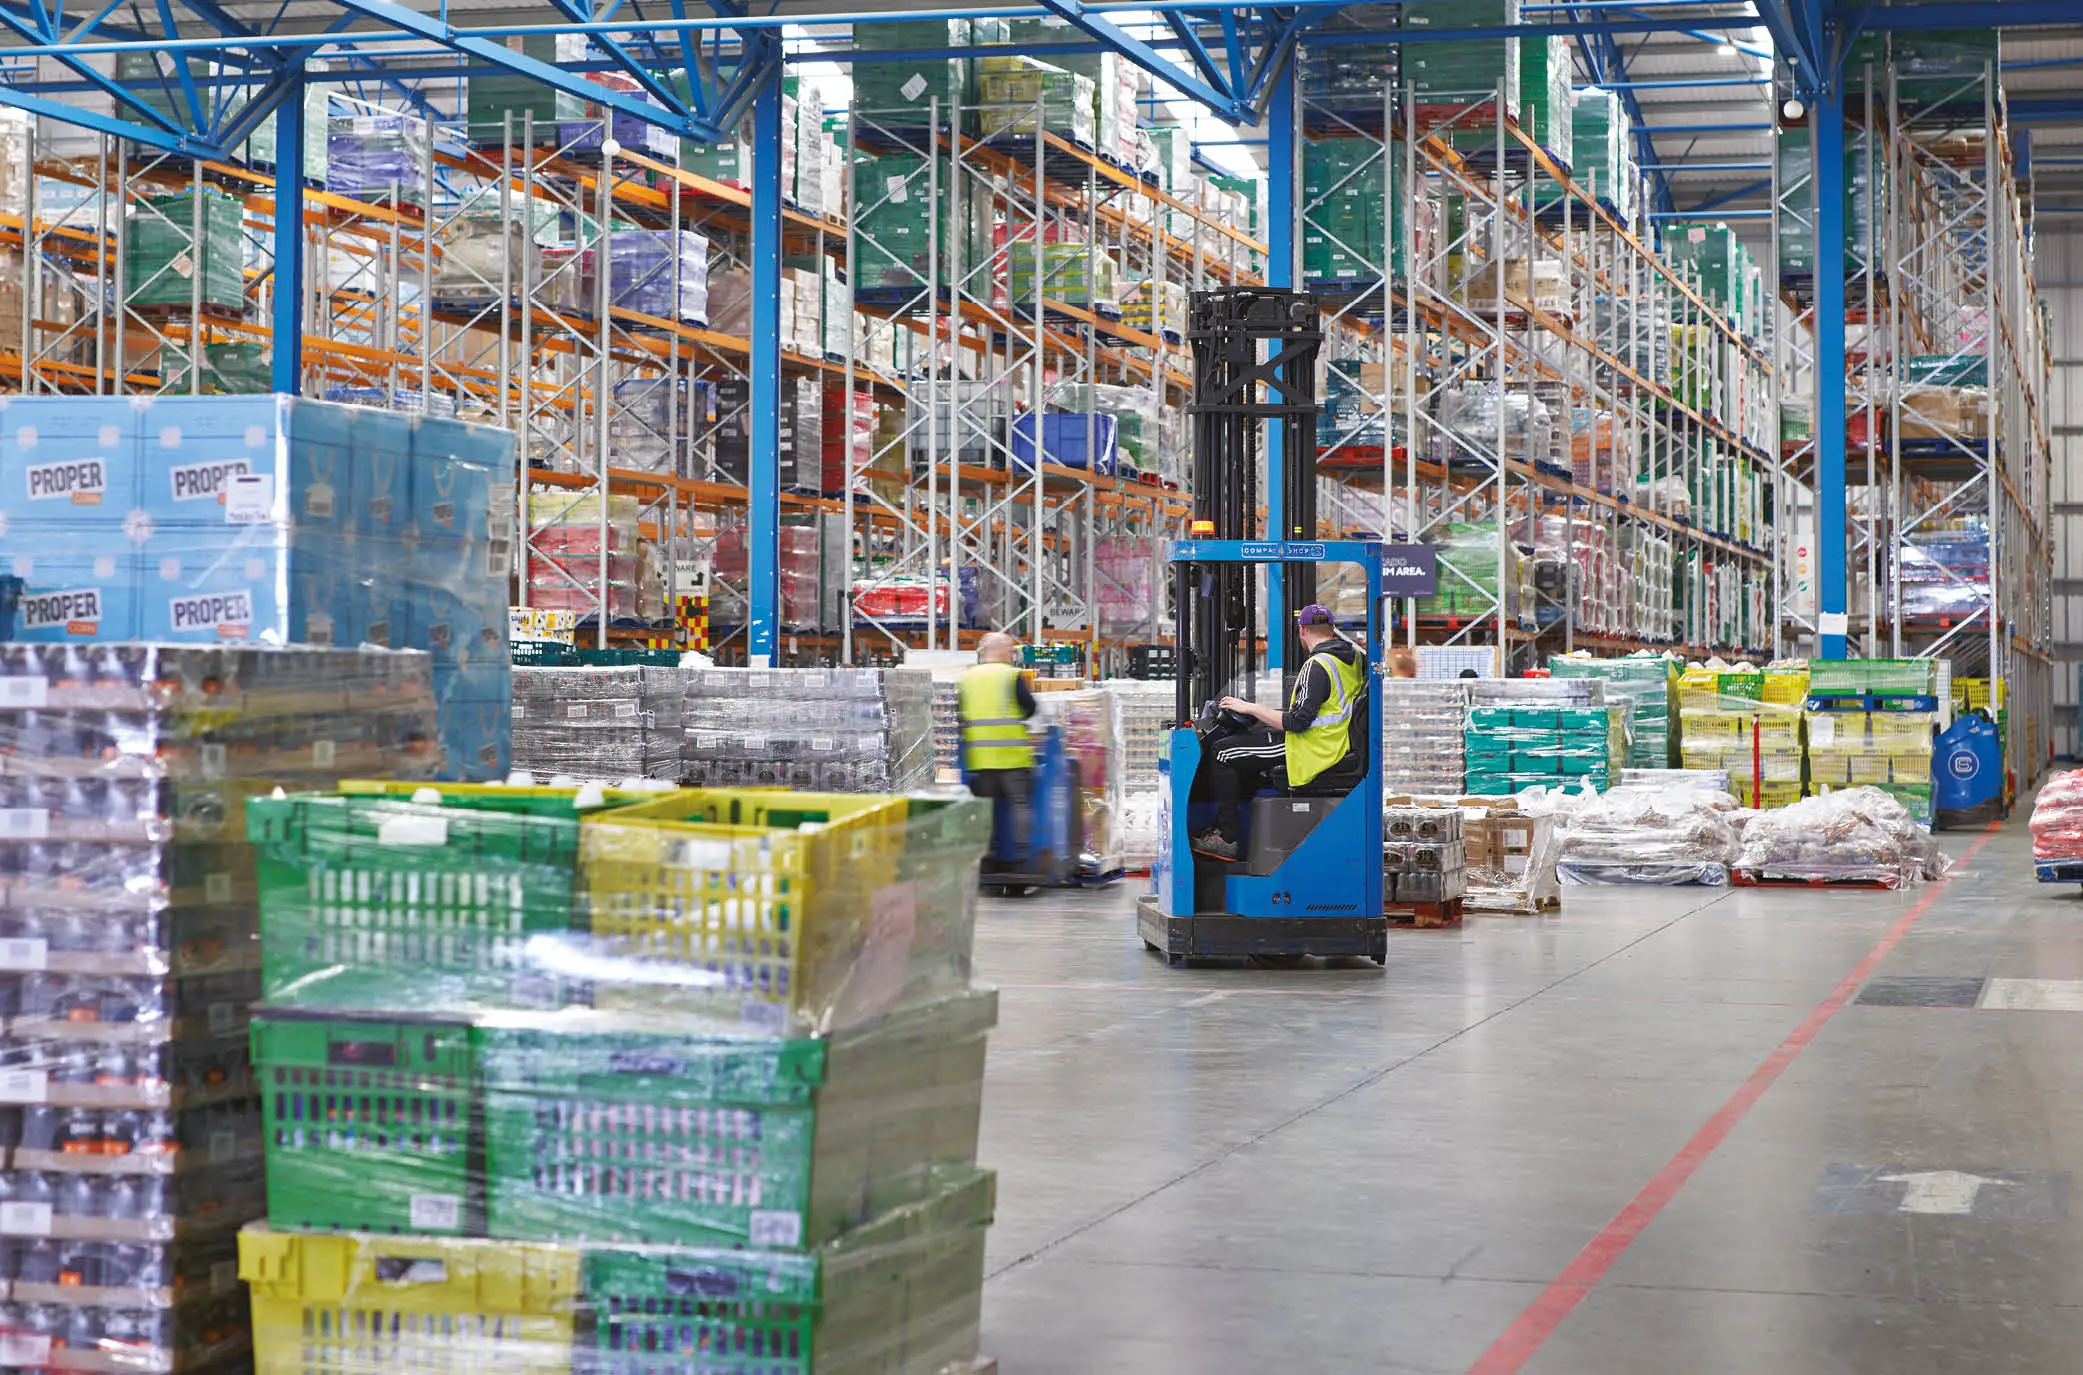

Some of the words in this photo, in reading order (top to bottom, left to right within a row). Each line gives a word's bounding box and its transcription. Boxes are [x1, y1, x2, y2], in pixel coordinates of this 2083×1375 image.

[30, 462, 103, 495] PROPER
[662, 564, 697, 573] BWARE
[1396, 567, 1426, 576] AREA.
[26, 592, 98, 625] PROPER
